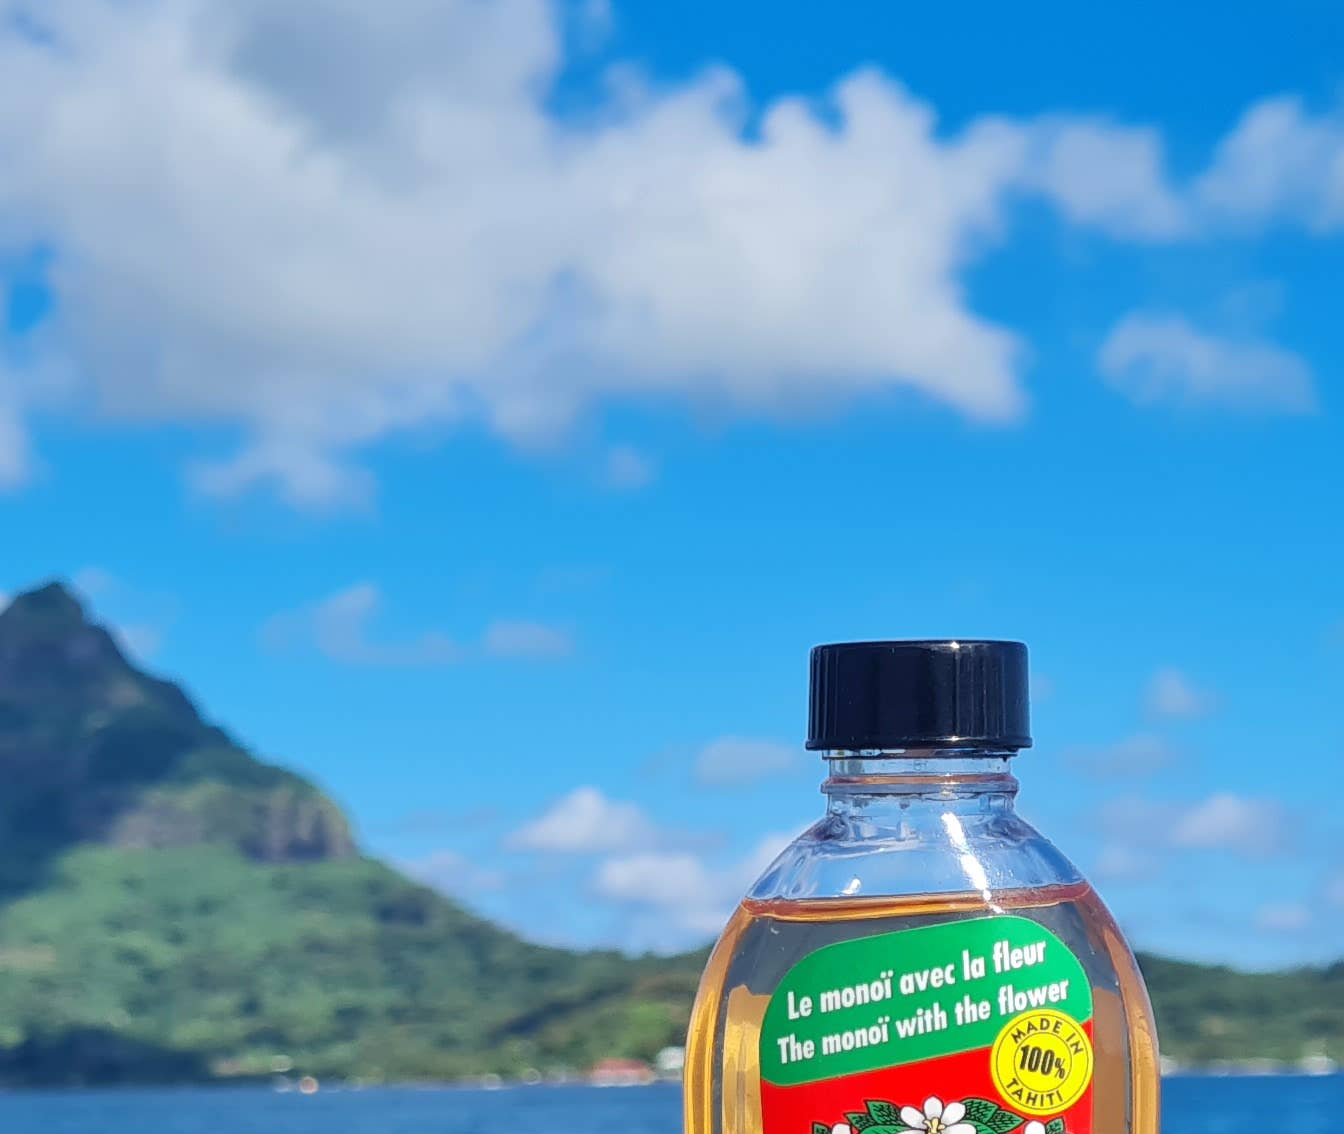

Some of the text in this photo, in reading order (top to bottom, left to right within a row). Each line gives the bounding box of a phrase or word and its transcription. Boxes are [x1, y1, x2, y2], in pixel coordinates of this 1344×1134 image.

[787, 939, 1046, 1020] Le monoï avec la fleur
[777, 979, 1069, 1064] The monoï with the flower
[1011, 1017, 1083, 1056] MADE IN
[1019, 1044, 1066, 1080] 100%
[1006, 1077, 1063, 1107] TAHITI
